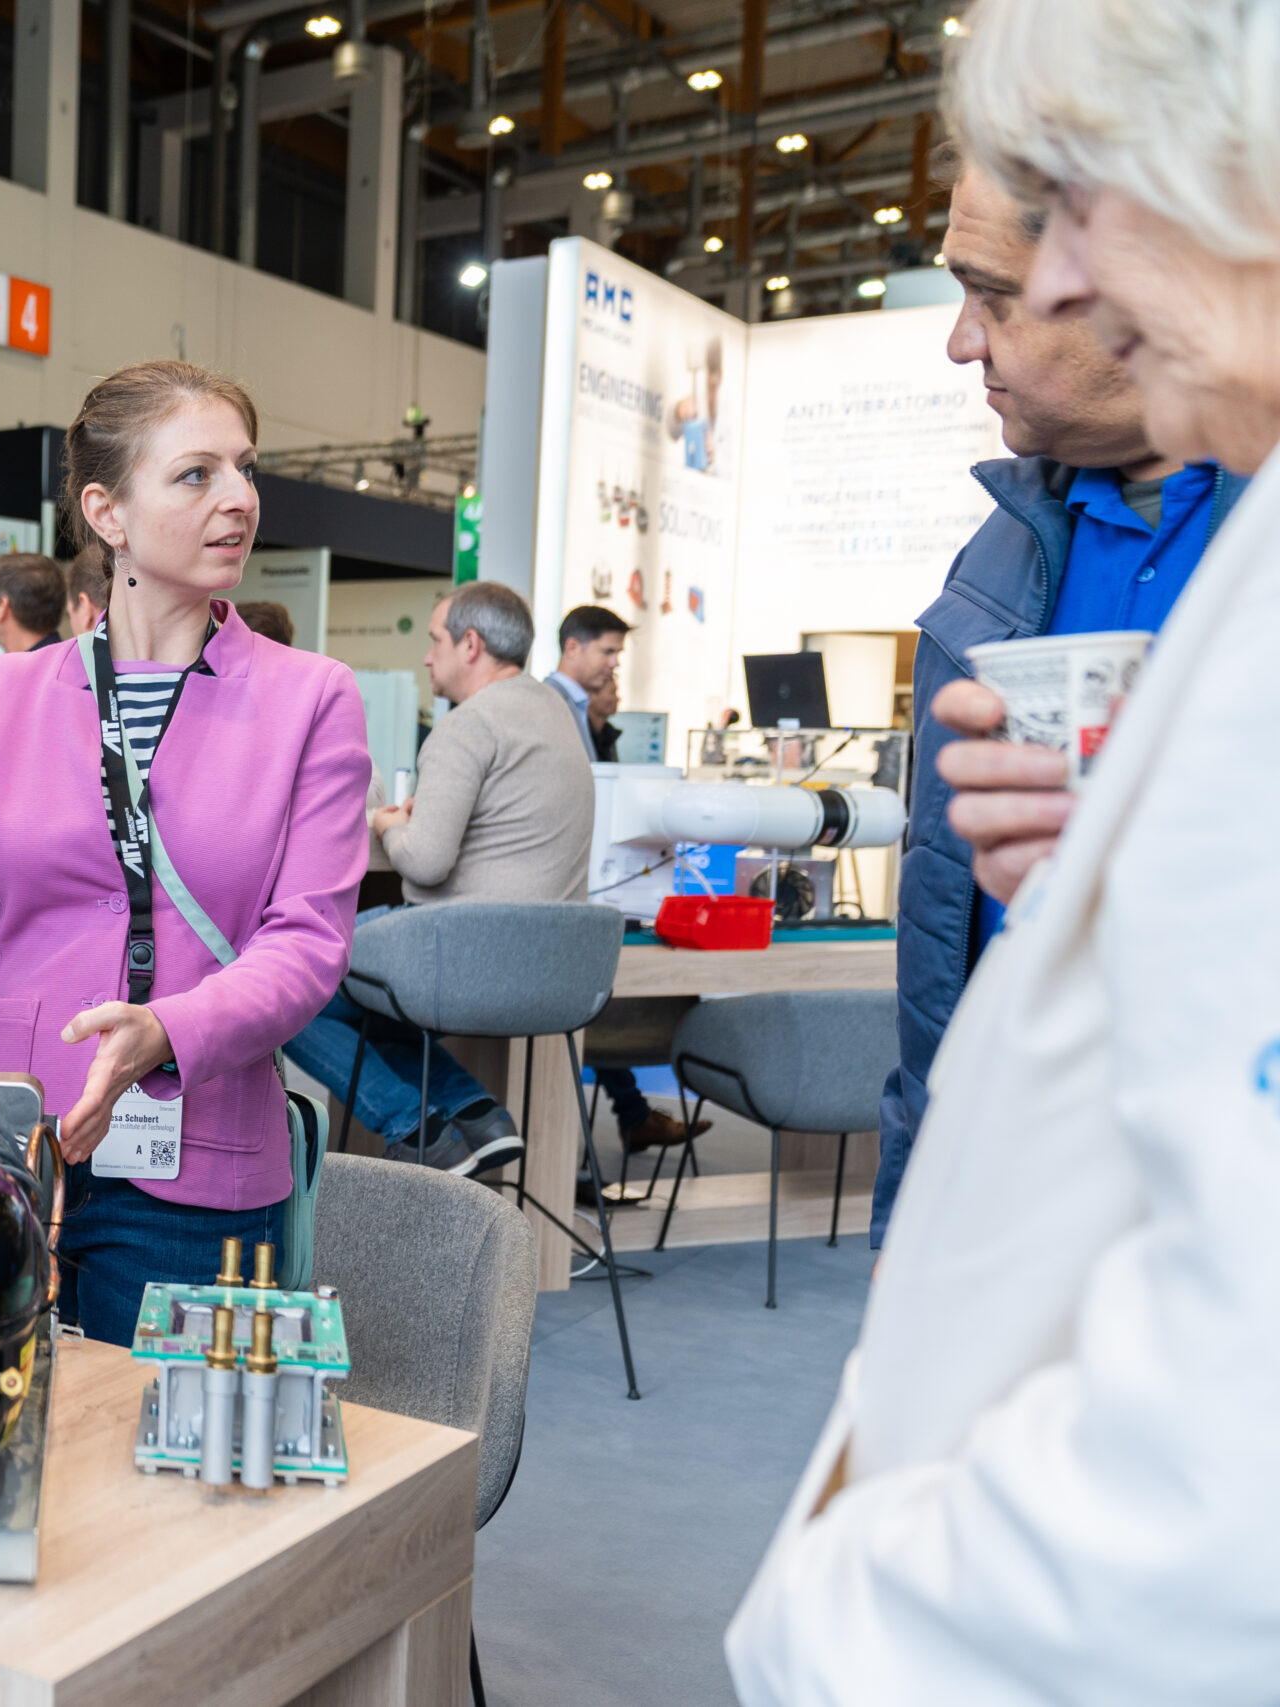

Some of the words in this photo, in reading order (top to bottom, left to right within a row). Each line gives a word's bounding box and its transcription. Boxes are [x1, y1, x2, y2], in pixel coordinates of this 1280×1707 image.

[21, 294, 38, 342] 4
[580, 363, 664, 423] ENGINEERING
[125, 1114, 159, 1124] Schubert
[136, 1145, 142, 1155] A
